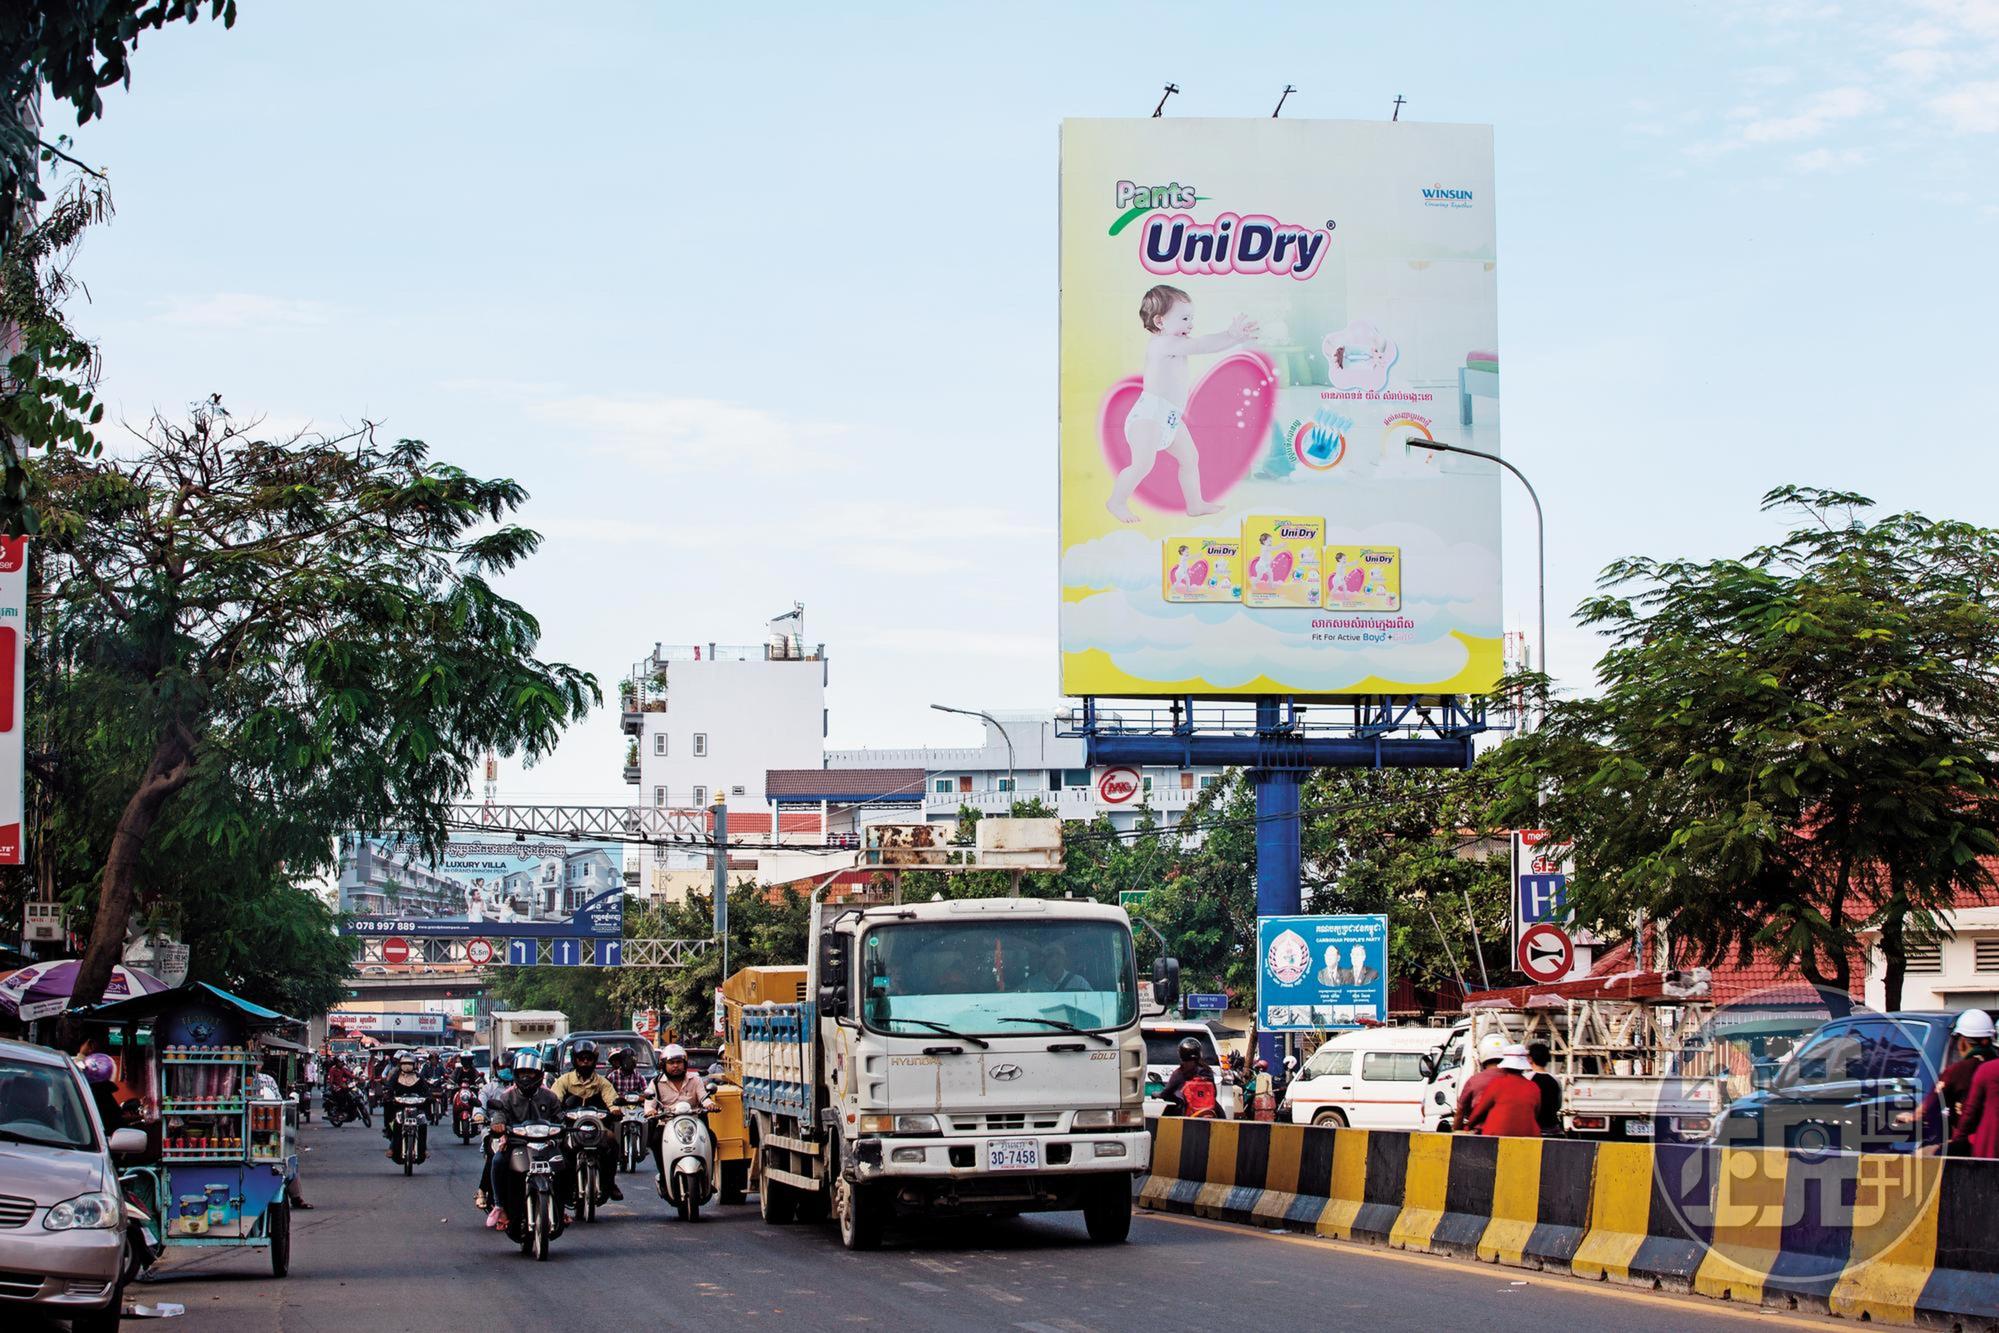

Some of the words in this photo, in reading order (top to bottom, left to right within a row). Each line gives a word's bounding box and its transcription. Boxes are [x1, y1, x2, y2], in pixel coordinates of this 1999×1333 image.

[1115, 180, 1197, 210] Pants
[1421, 187, 1473, 200] WINSUN
[446, 861, 480, 869] LUXURY
[482, 861, 507, 869] VILLA
[1531, 880, 1558, 917] H
[355, 921, 375, 931] 078
[377, 921, 395, 931] 997
[397, 921, 416, 931] 889
[1090, 1052, 1118, 1061] GOLD
[991, 1150, 1036, 1165] 3D-7458
